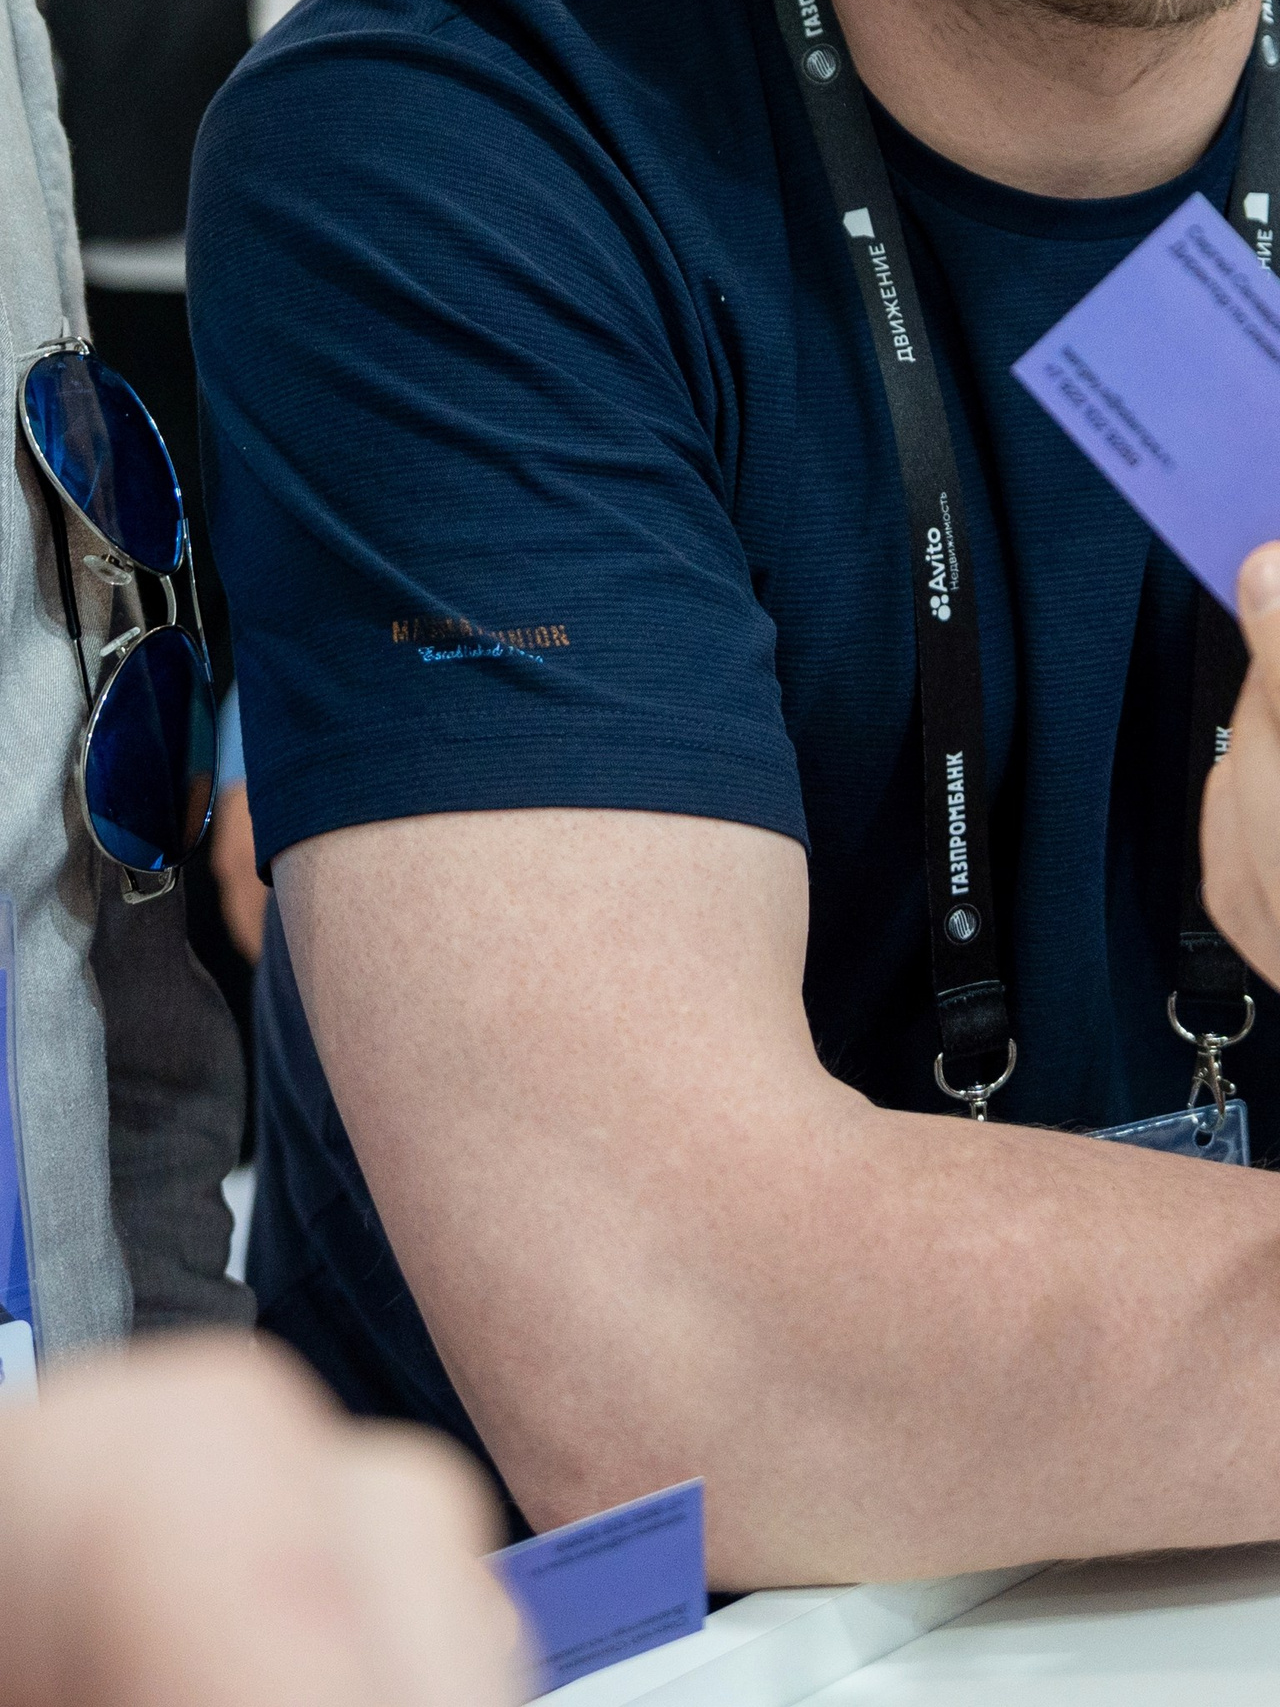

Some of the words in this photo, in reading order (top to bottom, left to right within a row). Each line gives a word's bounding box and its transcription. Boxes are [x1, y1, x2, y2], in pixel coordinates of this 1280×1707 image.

[868, 243, 916, 363] ДВИЖЕНИЕ
[926, 526, 949, 593] Avito
[940, 491, 962, 592] Недвижимость
[946, 750, 971, 894] ГАЗПРОМБАНК
